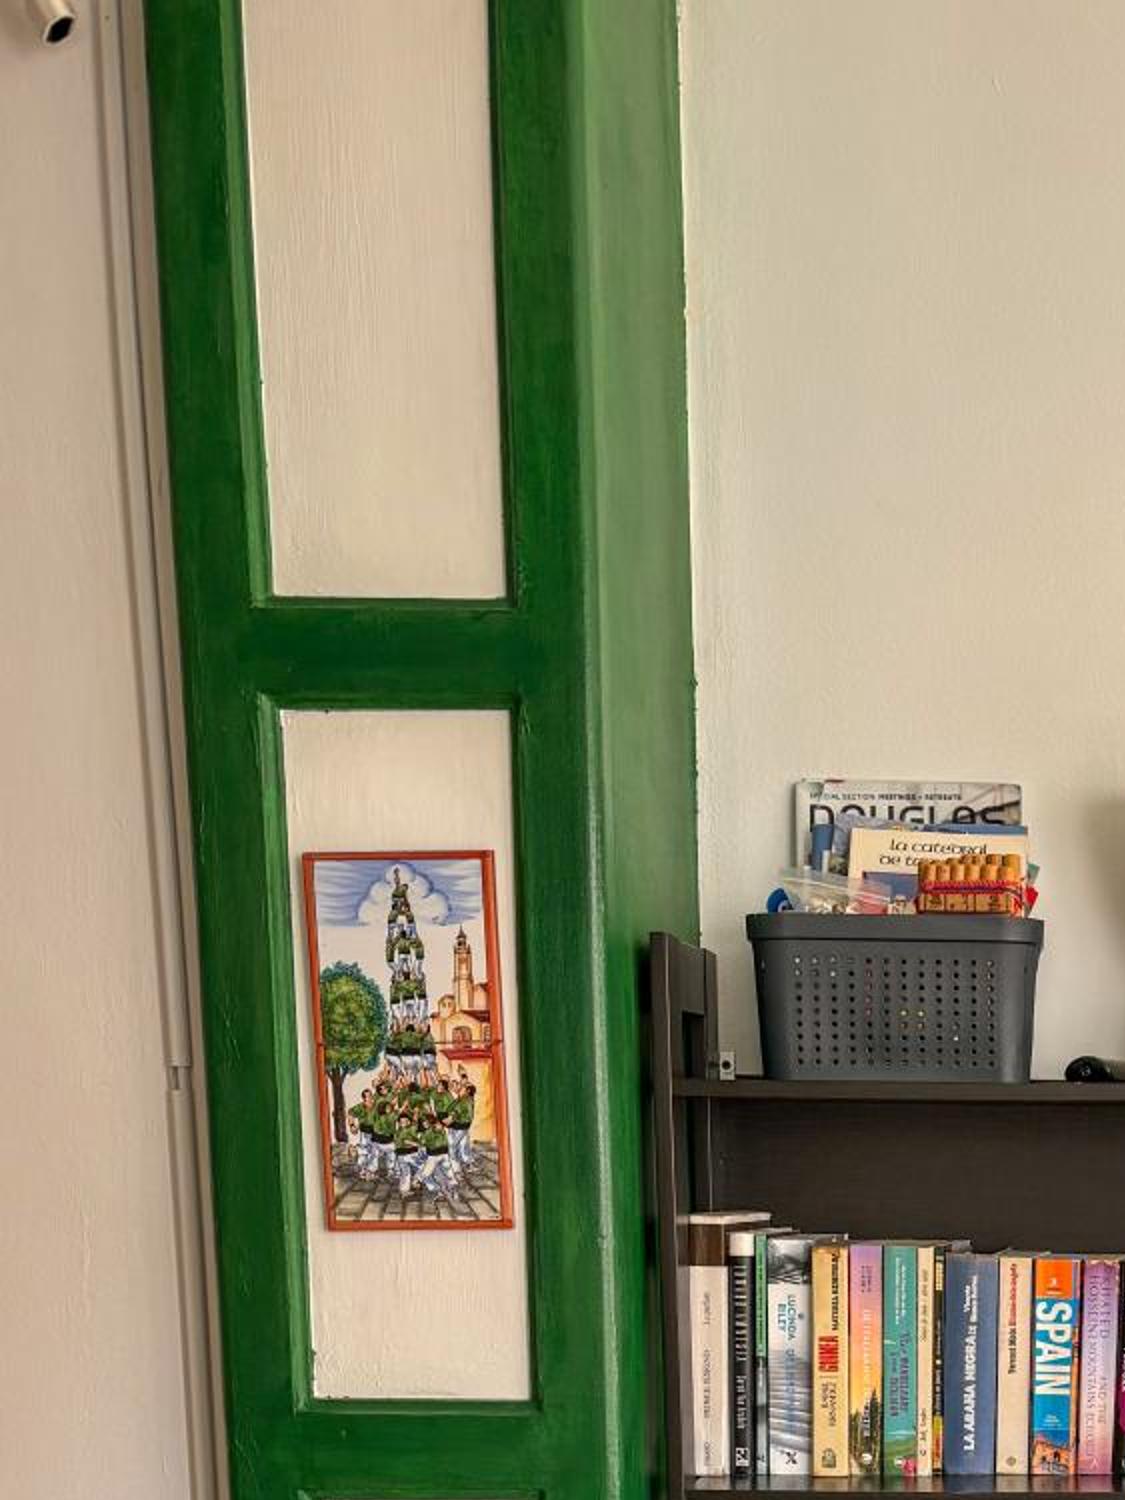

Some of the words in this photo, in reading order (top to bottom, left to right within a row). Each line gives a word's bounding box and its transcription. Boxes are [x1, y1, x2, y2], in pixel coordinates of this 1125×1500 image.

[777, 1302, 788, 1333] RILEY
[787, 1294, 797, 1341] LUCINDA
[1087, 1274, 1101, 1340] HOSSEINI
[1099, 1276, 1113, 1340] KHALED
[964, 1335, 977, 1381] NEGRA
[1034, 1301, 1073, 1396] SPAIN
[1086, 1341, 1099, 1409] MOUNTAINS
[963, 1434, 975, 1451] LA
